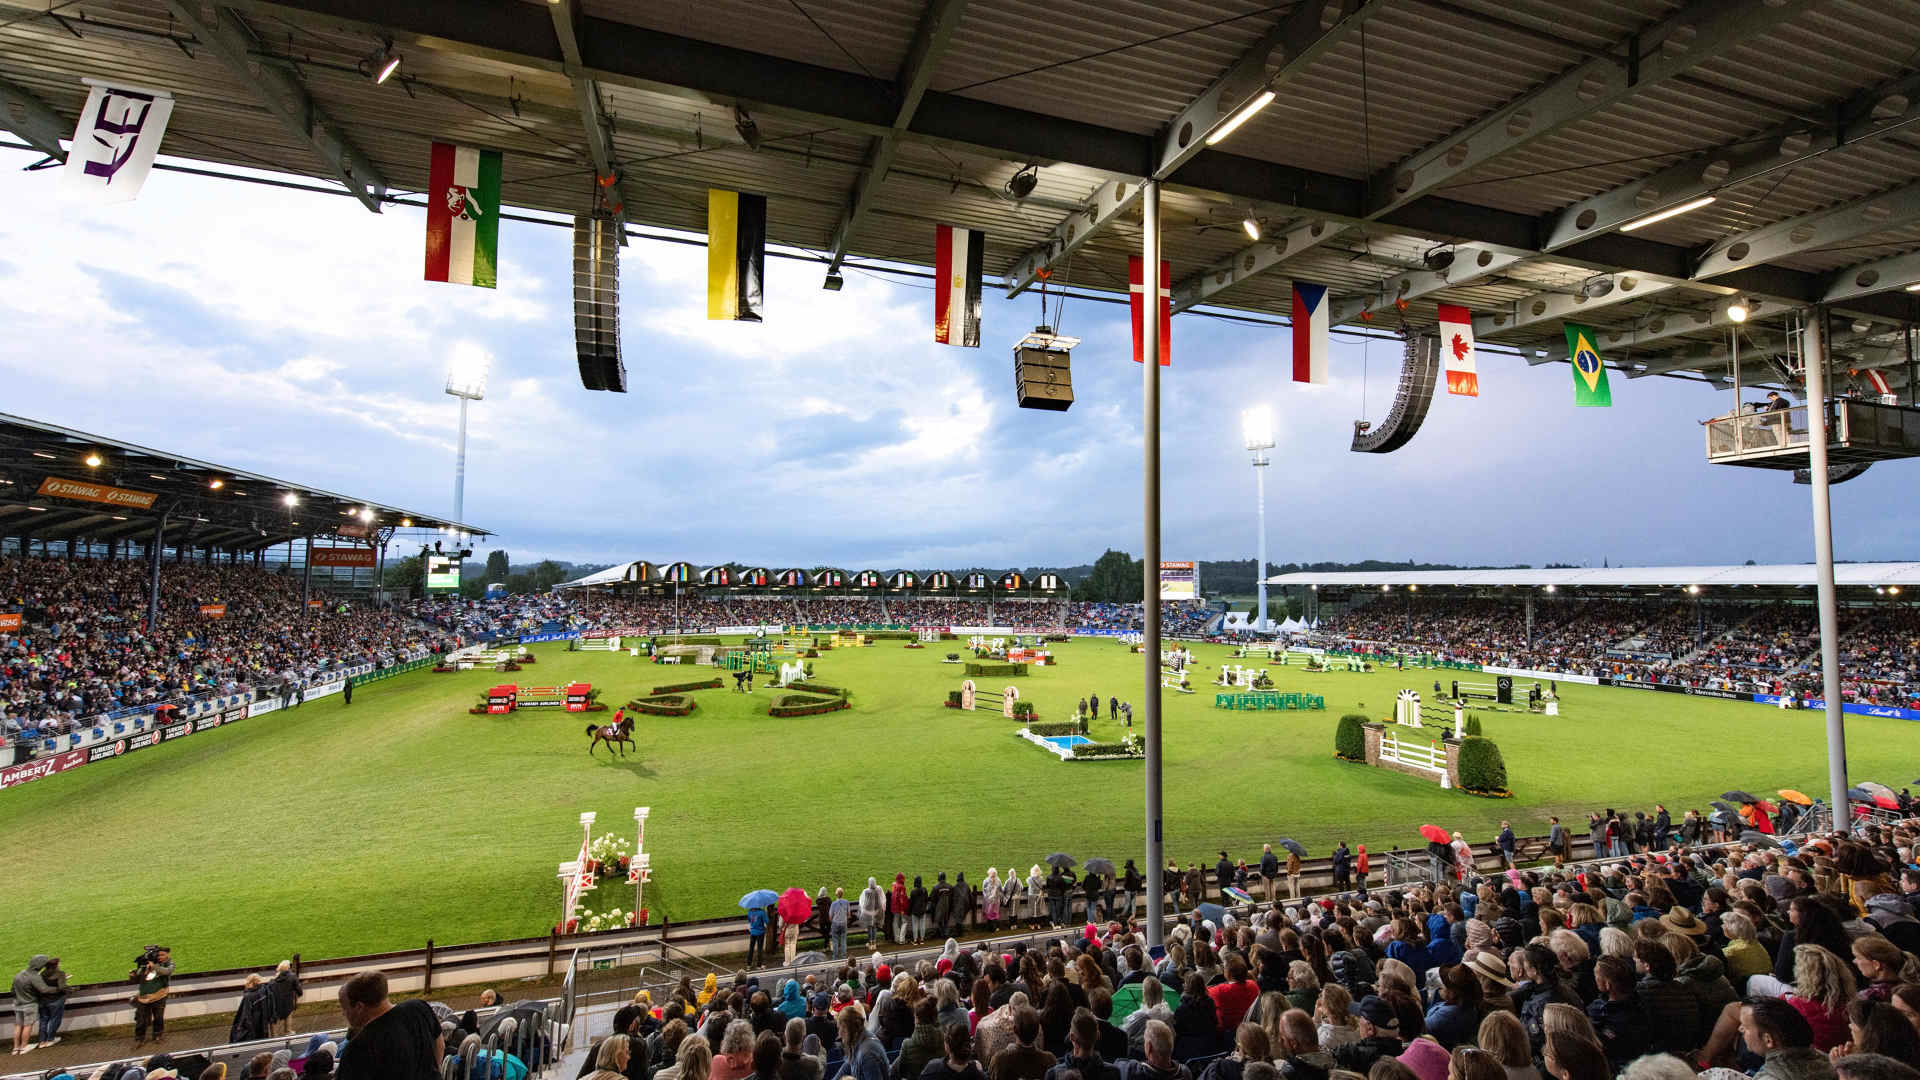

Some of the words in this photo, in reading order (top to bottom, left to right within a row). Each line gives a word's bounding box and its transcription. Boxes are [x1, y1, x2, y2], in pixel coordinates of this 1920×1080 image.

[59, 484, 101, 498] STAWAG
[118, 493, 153, 505] STAWAG
[328, 553, 372, 562] STAWAG
[1620, 681, 1655, 690] Mercedes-Benz
[1695, 689, 1737, 699] Mercedes-Benz
[91, 744, 114, 754] TURKISH
[90, 751, 114, 761] AIRLINES
[0, 758, 56, 790] LAMBERTZ
